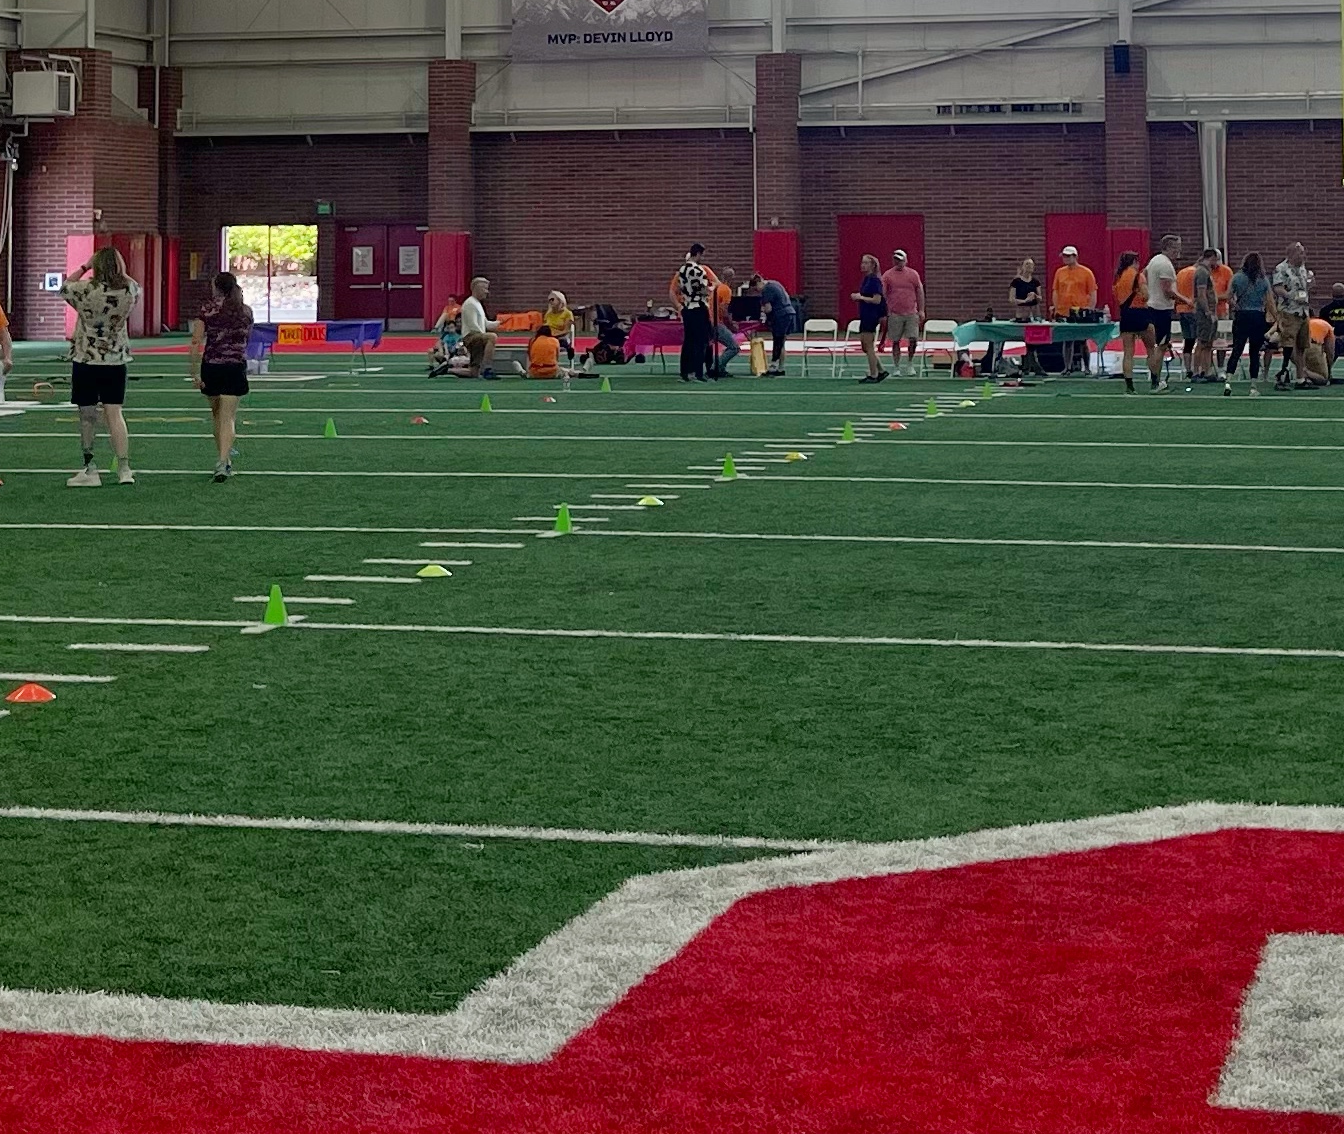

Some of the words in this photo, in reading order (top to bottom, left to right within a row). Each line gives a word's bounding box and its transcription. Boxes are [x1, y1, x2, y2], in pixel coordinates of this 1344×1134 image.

[547, 32, 581, 45] MVP:
[584, 31, 627, 44] DEVIN
[629, 30, 673, 43] LLOYD
